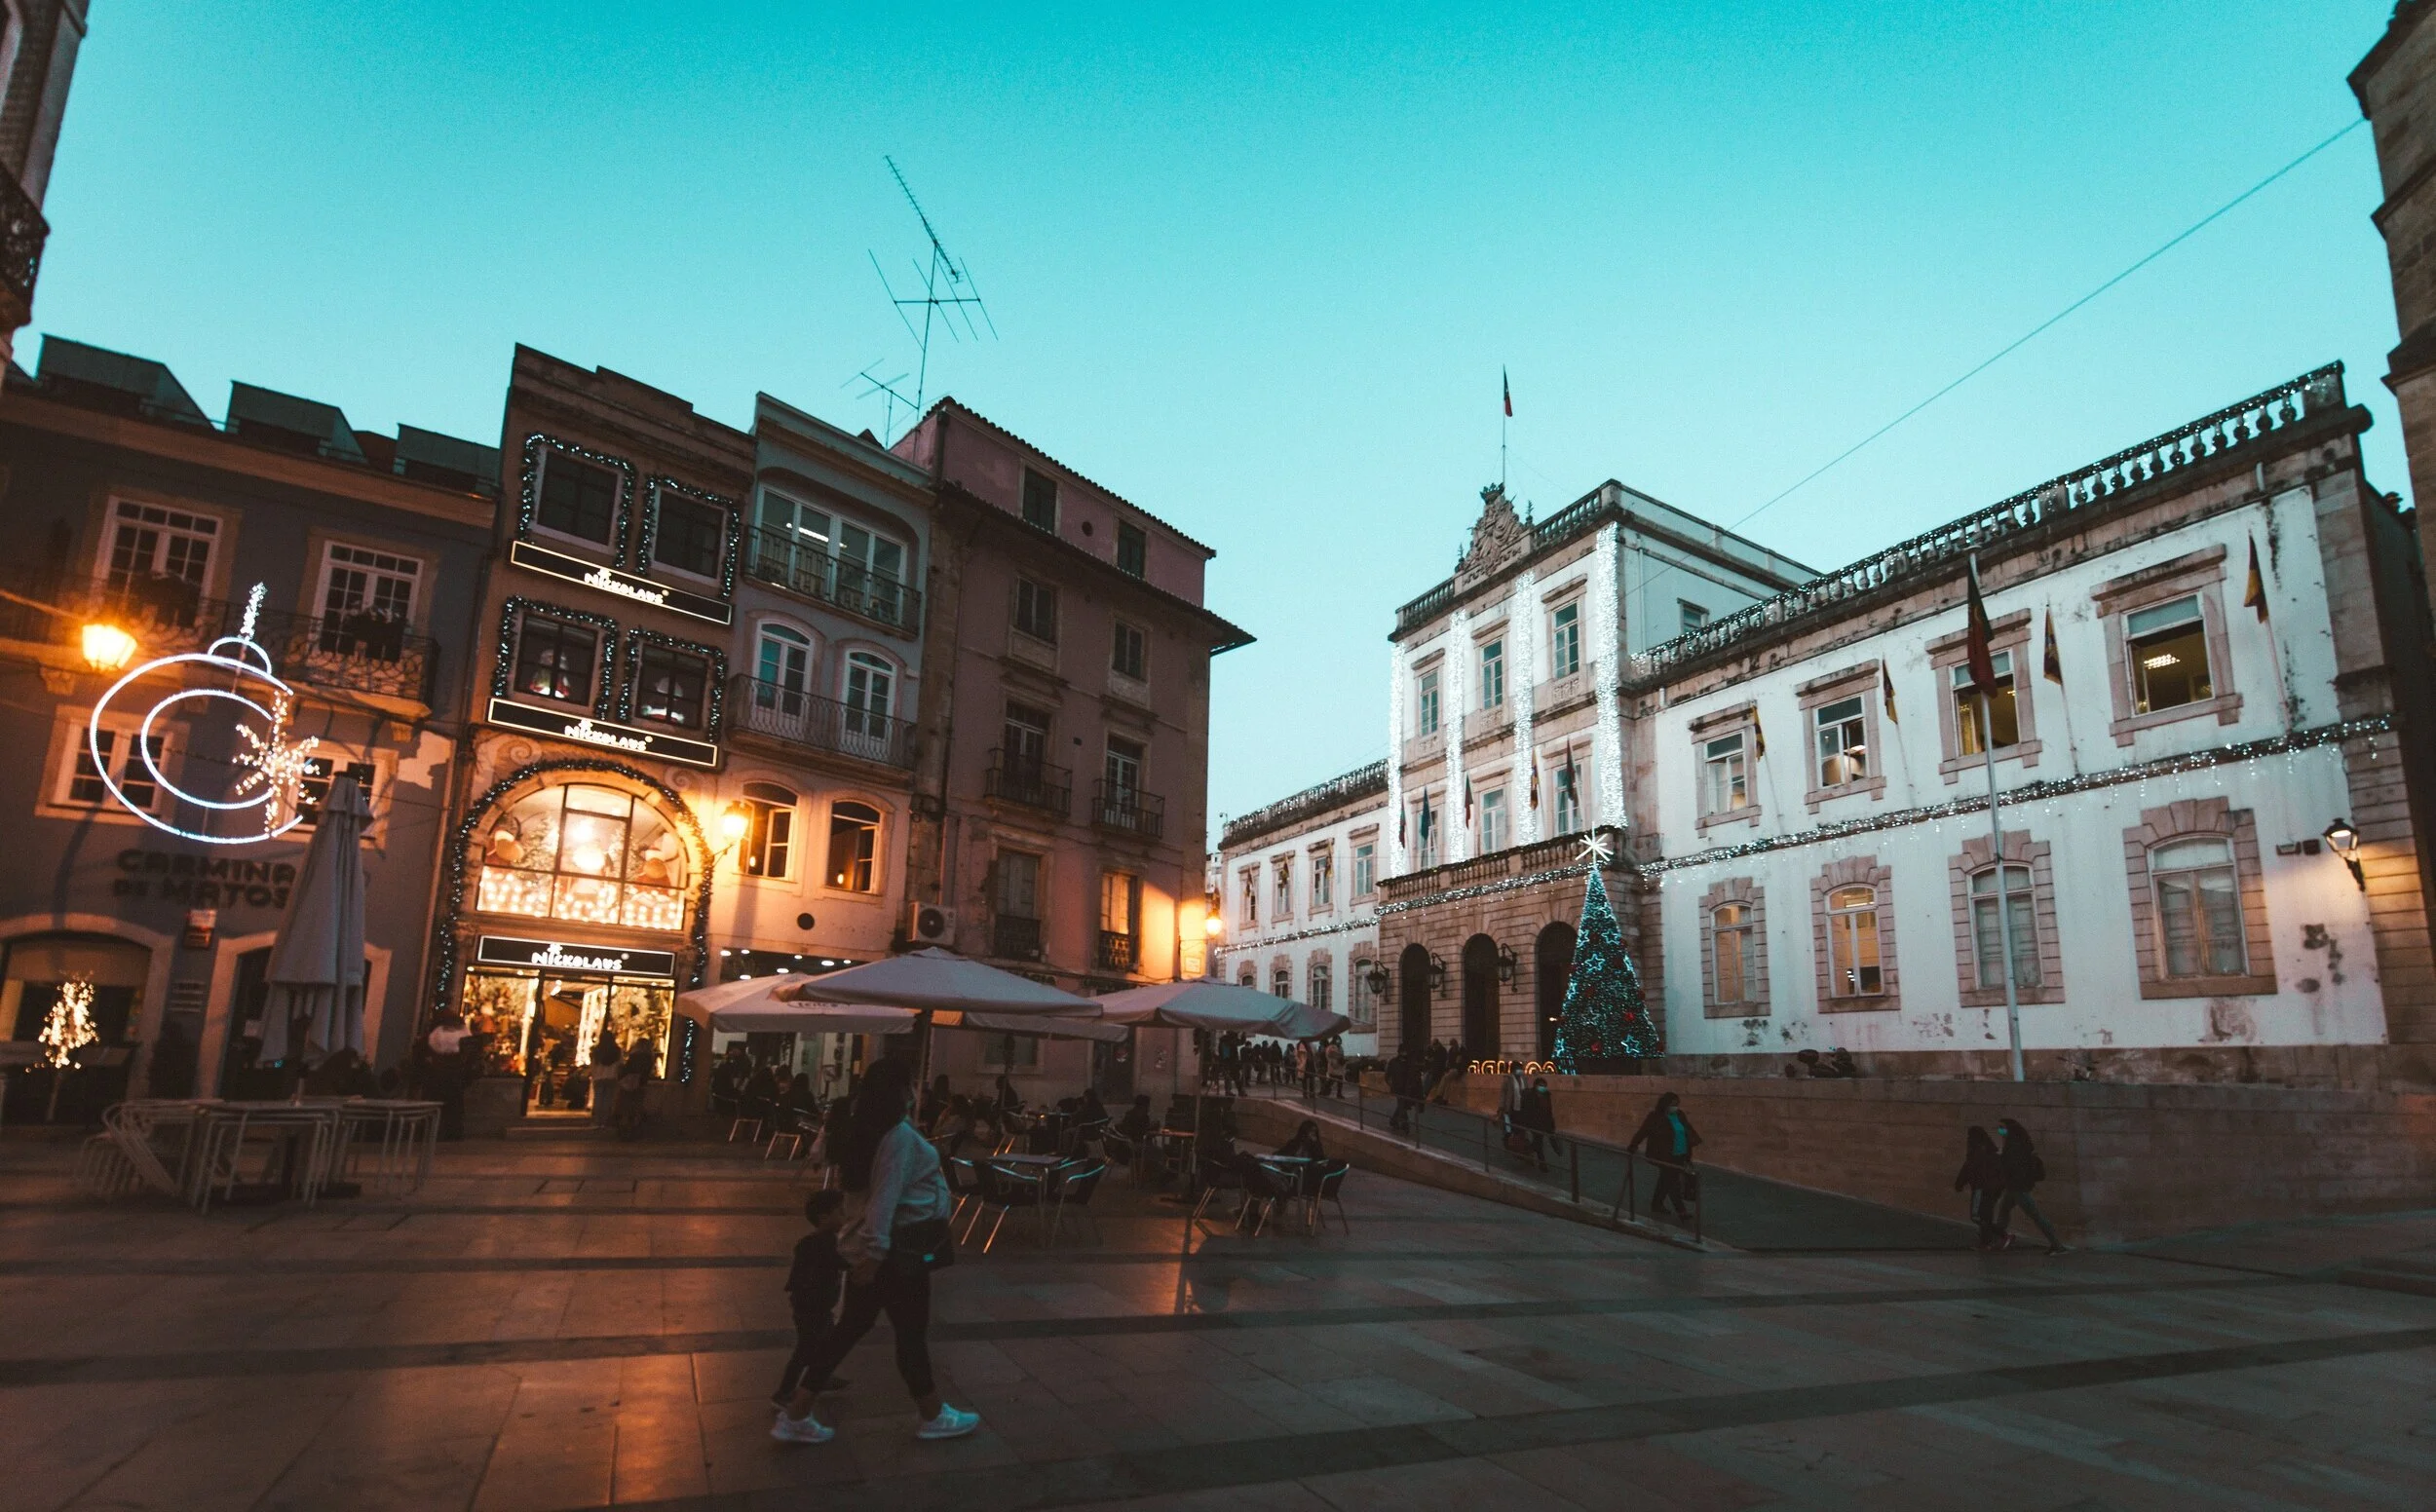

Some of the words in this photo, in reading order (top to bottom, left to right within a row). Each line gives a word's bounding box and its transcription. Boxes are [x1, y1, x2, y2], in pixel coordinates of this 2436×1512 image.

[117, 849, 297, 885] CARMINA
[159, 878, 291, 909] MATOS
[531, 947, 623, 970] NICKOLAUS
